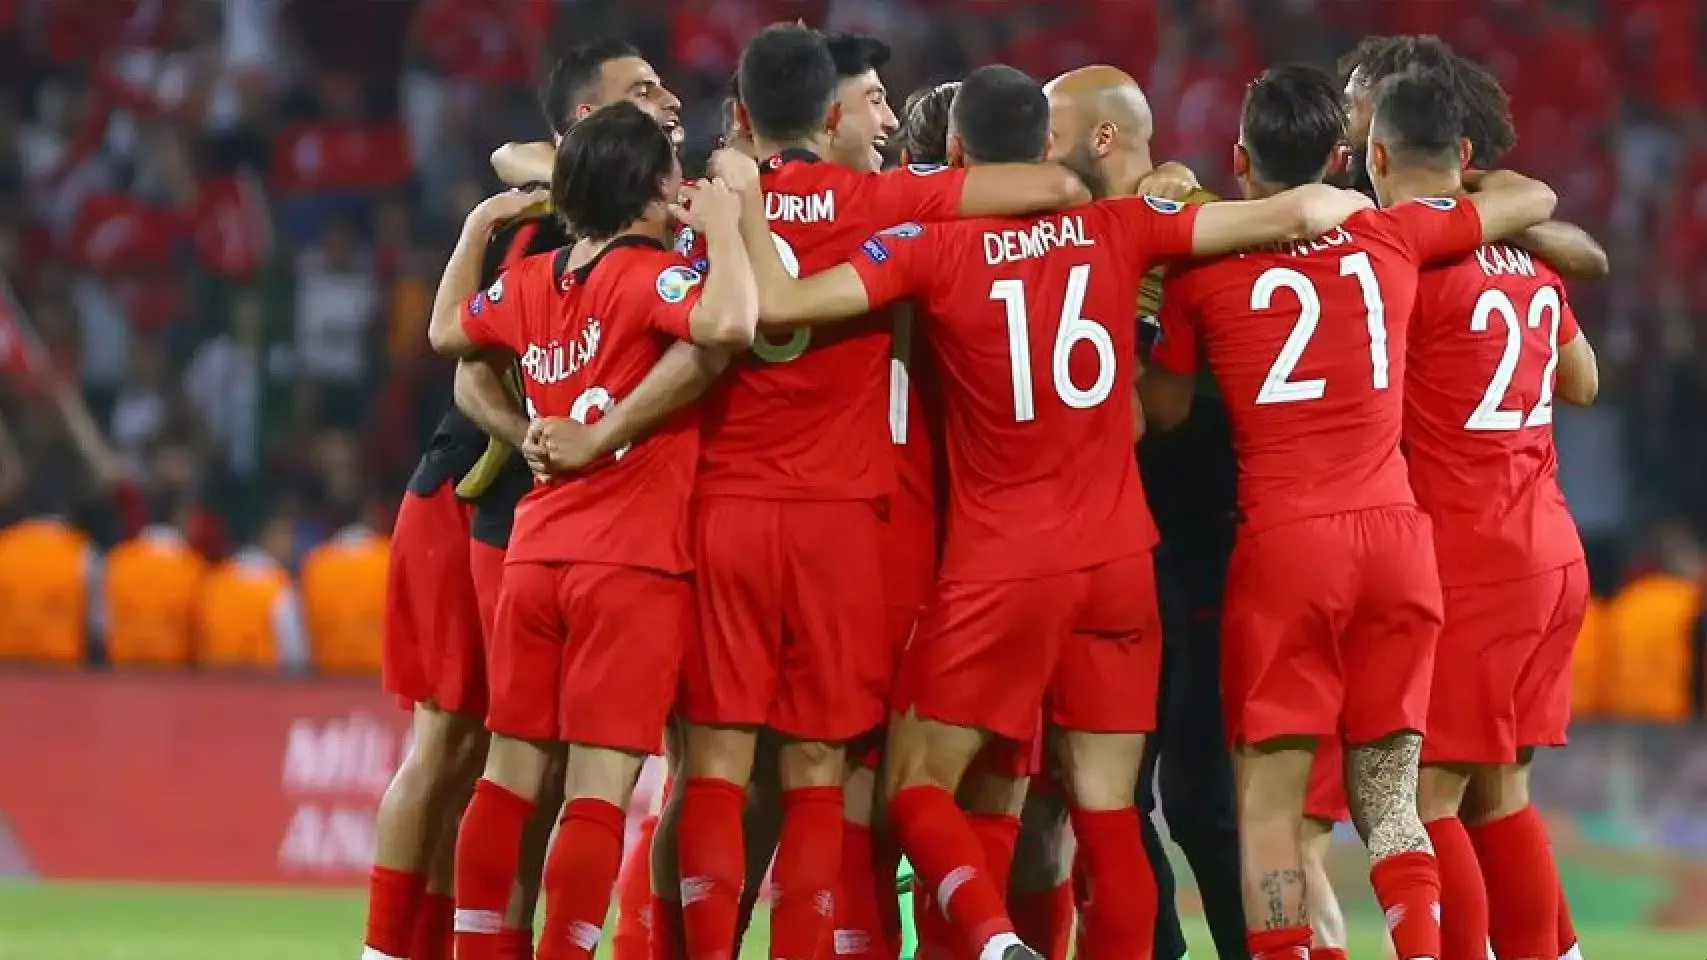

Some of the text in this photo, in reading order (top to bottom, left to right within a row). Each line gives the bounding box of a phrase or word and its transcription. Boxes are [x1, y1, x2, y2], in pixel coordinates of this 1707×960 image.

[1250, 251, 1389, 405] 21
[1475, 245, 1537, 277] KAAN
[989, 263, 1118, 423] 16
[1463, 284, 1561, 430] 22
